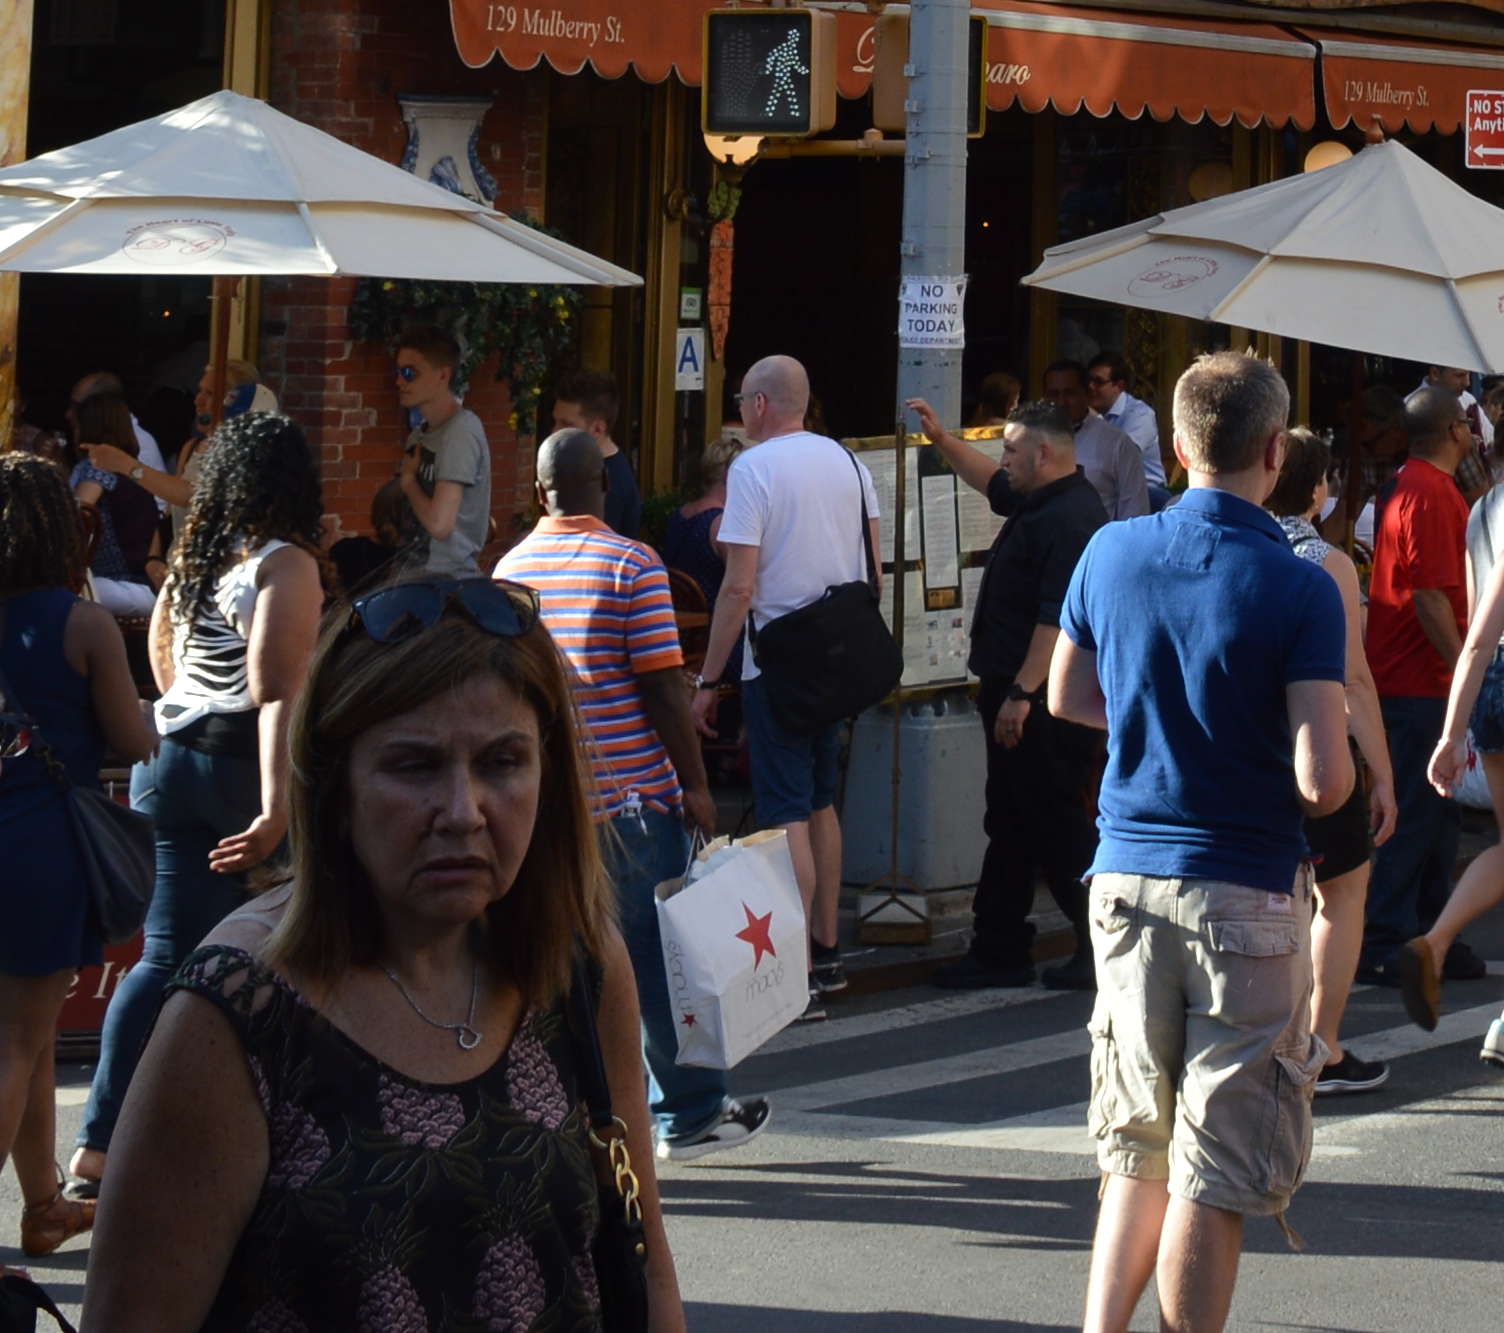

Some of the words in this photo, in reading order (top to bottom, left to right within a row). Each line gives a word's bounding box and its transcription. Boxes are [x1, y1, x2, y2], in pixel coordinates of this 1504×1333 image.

[485, 4, 518, 33] 129
[522, 8, 602, 47] Mulberry
[604, 15, 627, 45] St.
[1342, 80, 1364, 103] 129
[1365, 81, 1416, 111] Mulberry
[1415, 84, 1431, 108] St.
[1473, 99, 1493, 116] NO
[920, 284, 944, 298] NO
[904, 302, 958, 316] PARKING
[906, 318, 956, 333] TODAY
[677, 335, 700, 374] A
